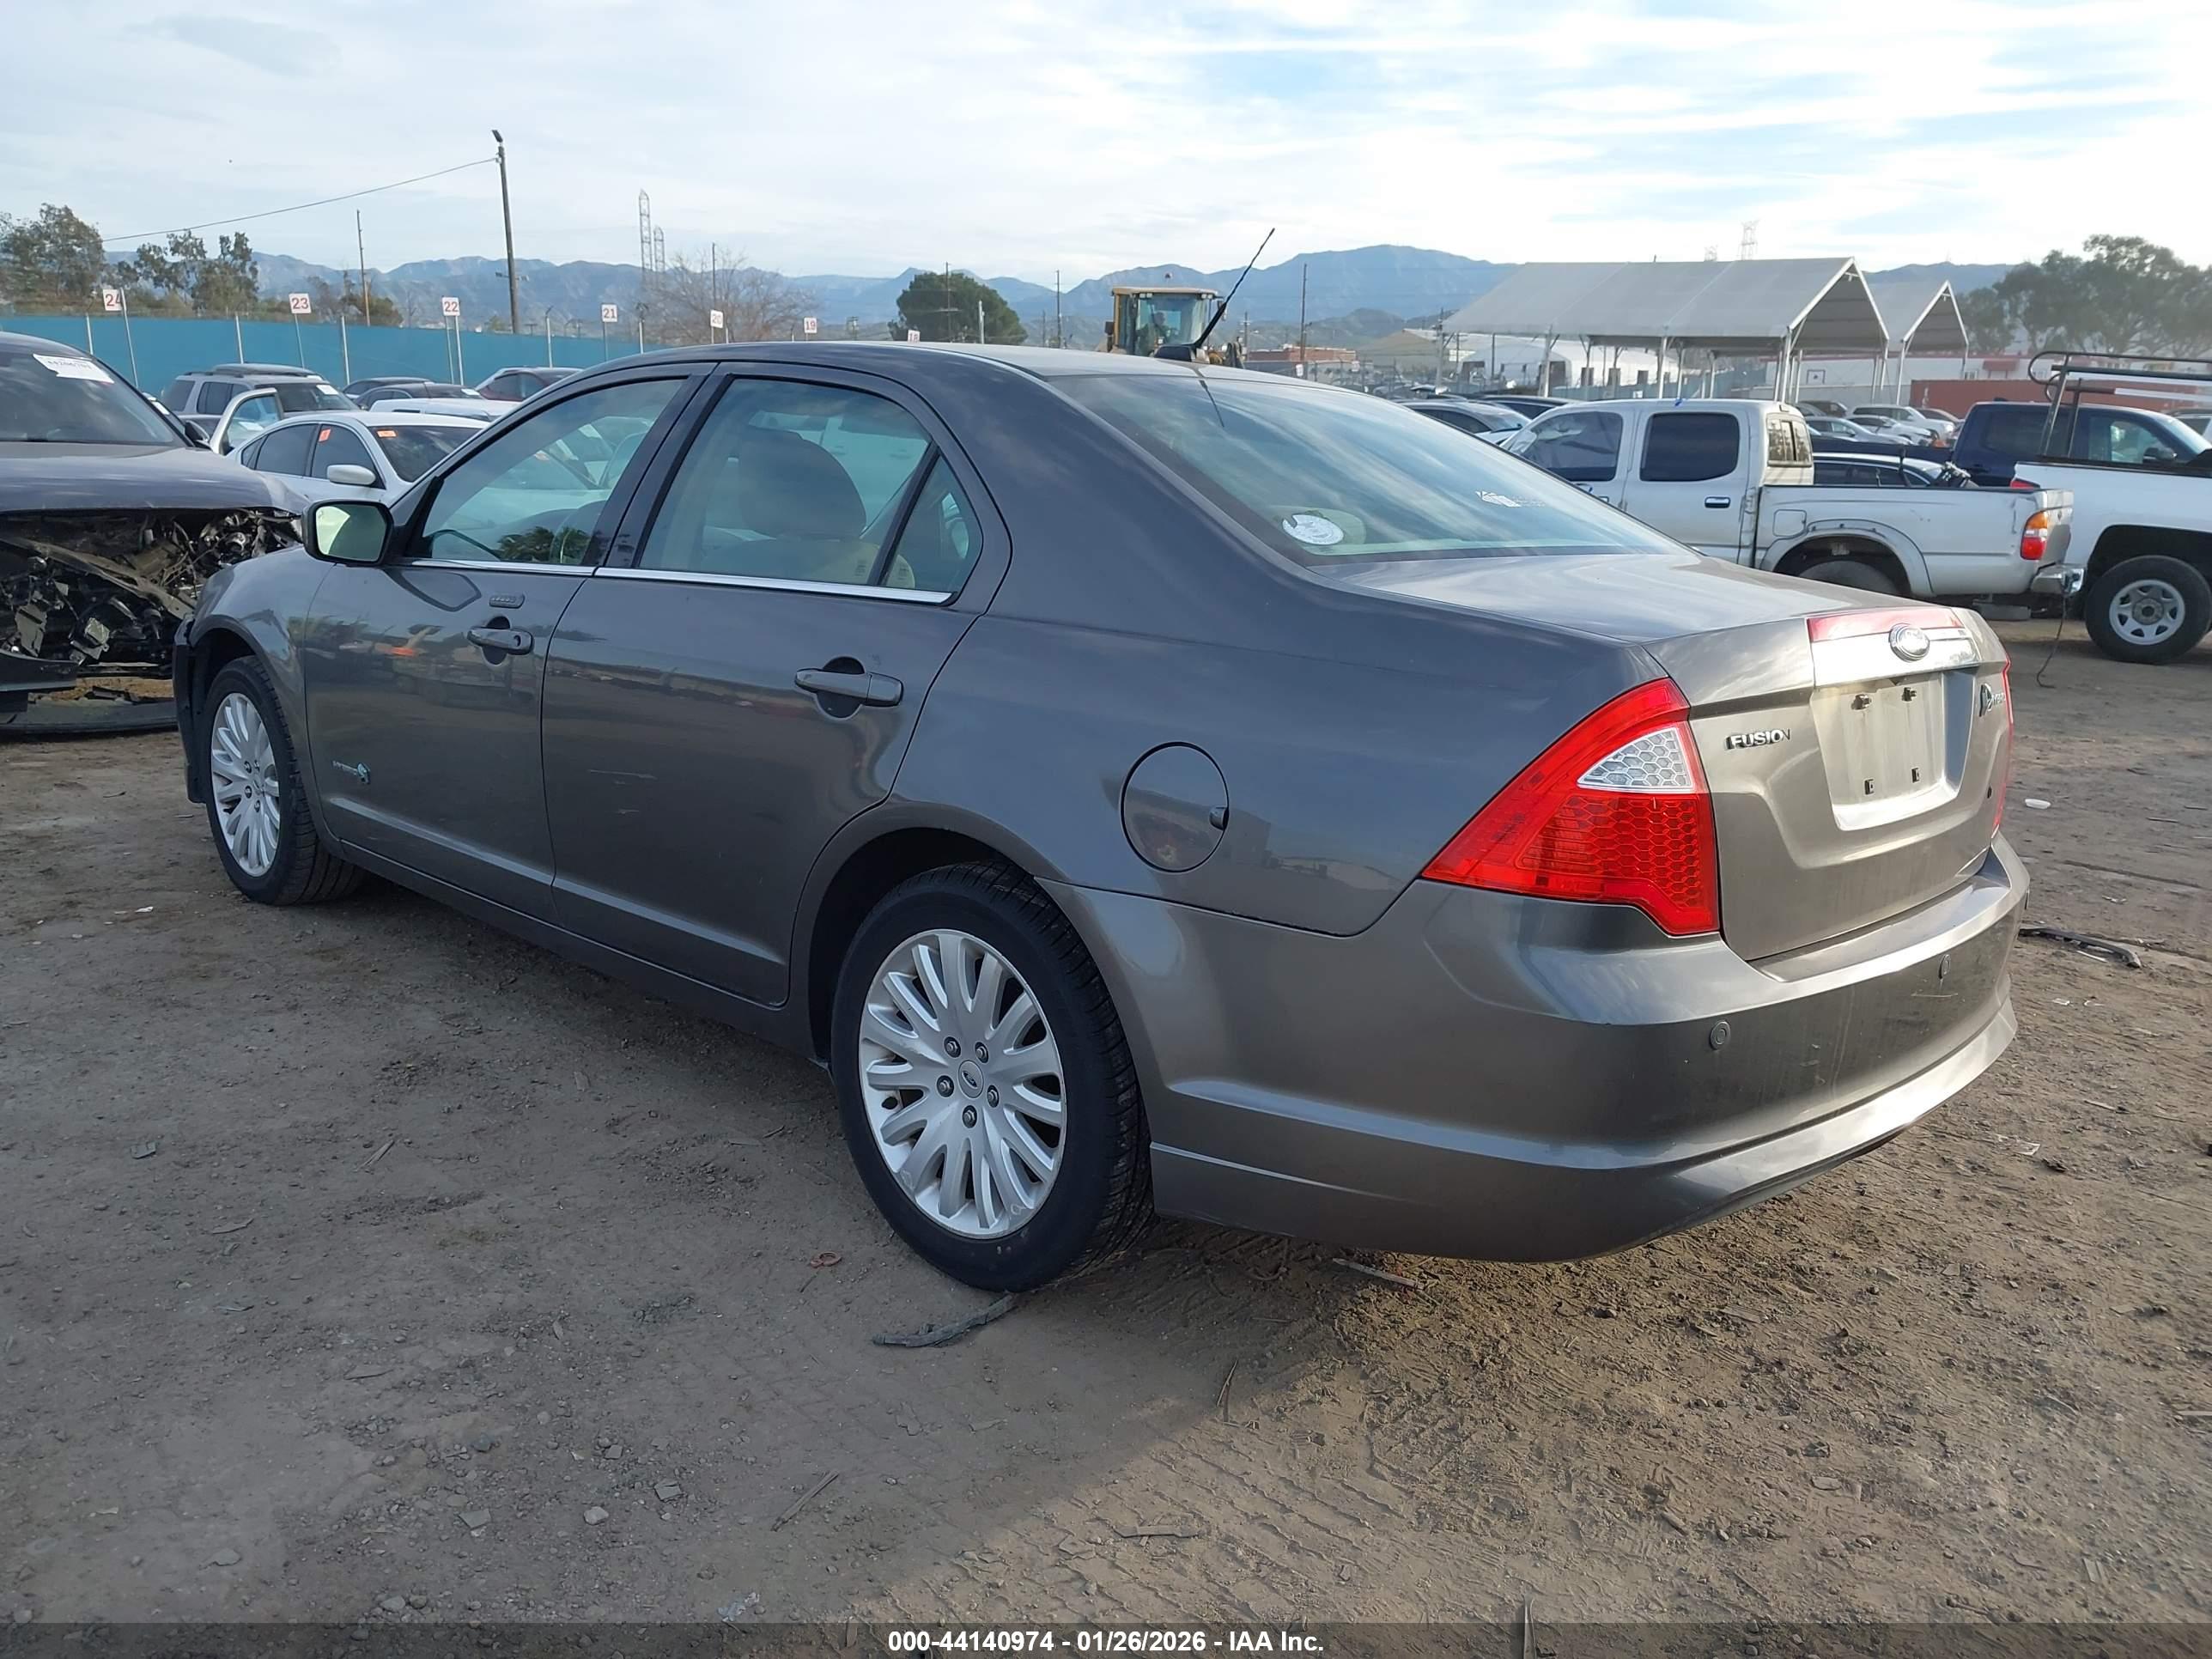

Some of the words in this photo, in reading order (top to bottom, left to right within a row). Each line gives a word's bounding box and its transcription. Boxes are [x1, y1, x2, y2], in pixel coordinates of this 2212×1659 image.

[292, 297, 309, 310] 23
[444, 301, 459, 313] 22
[603, 307, 616, 319] 21
[805, 319, 816, 331] 19
[1725, 728, 1790, 750] FUSION
